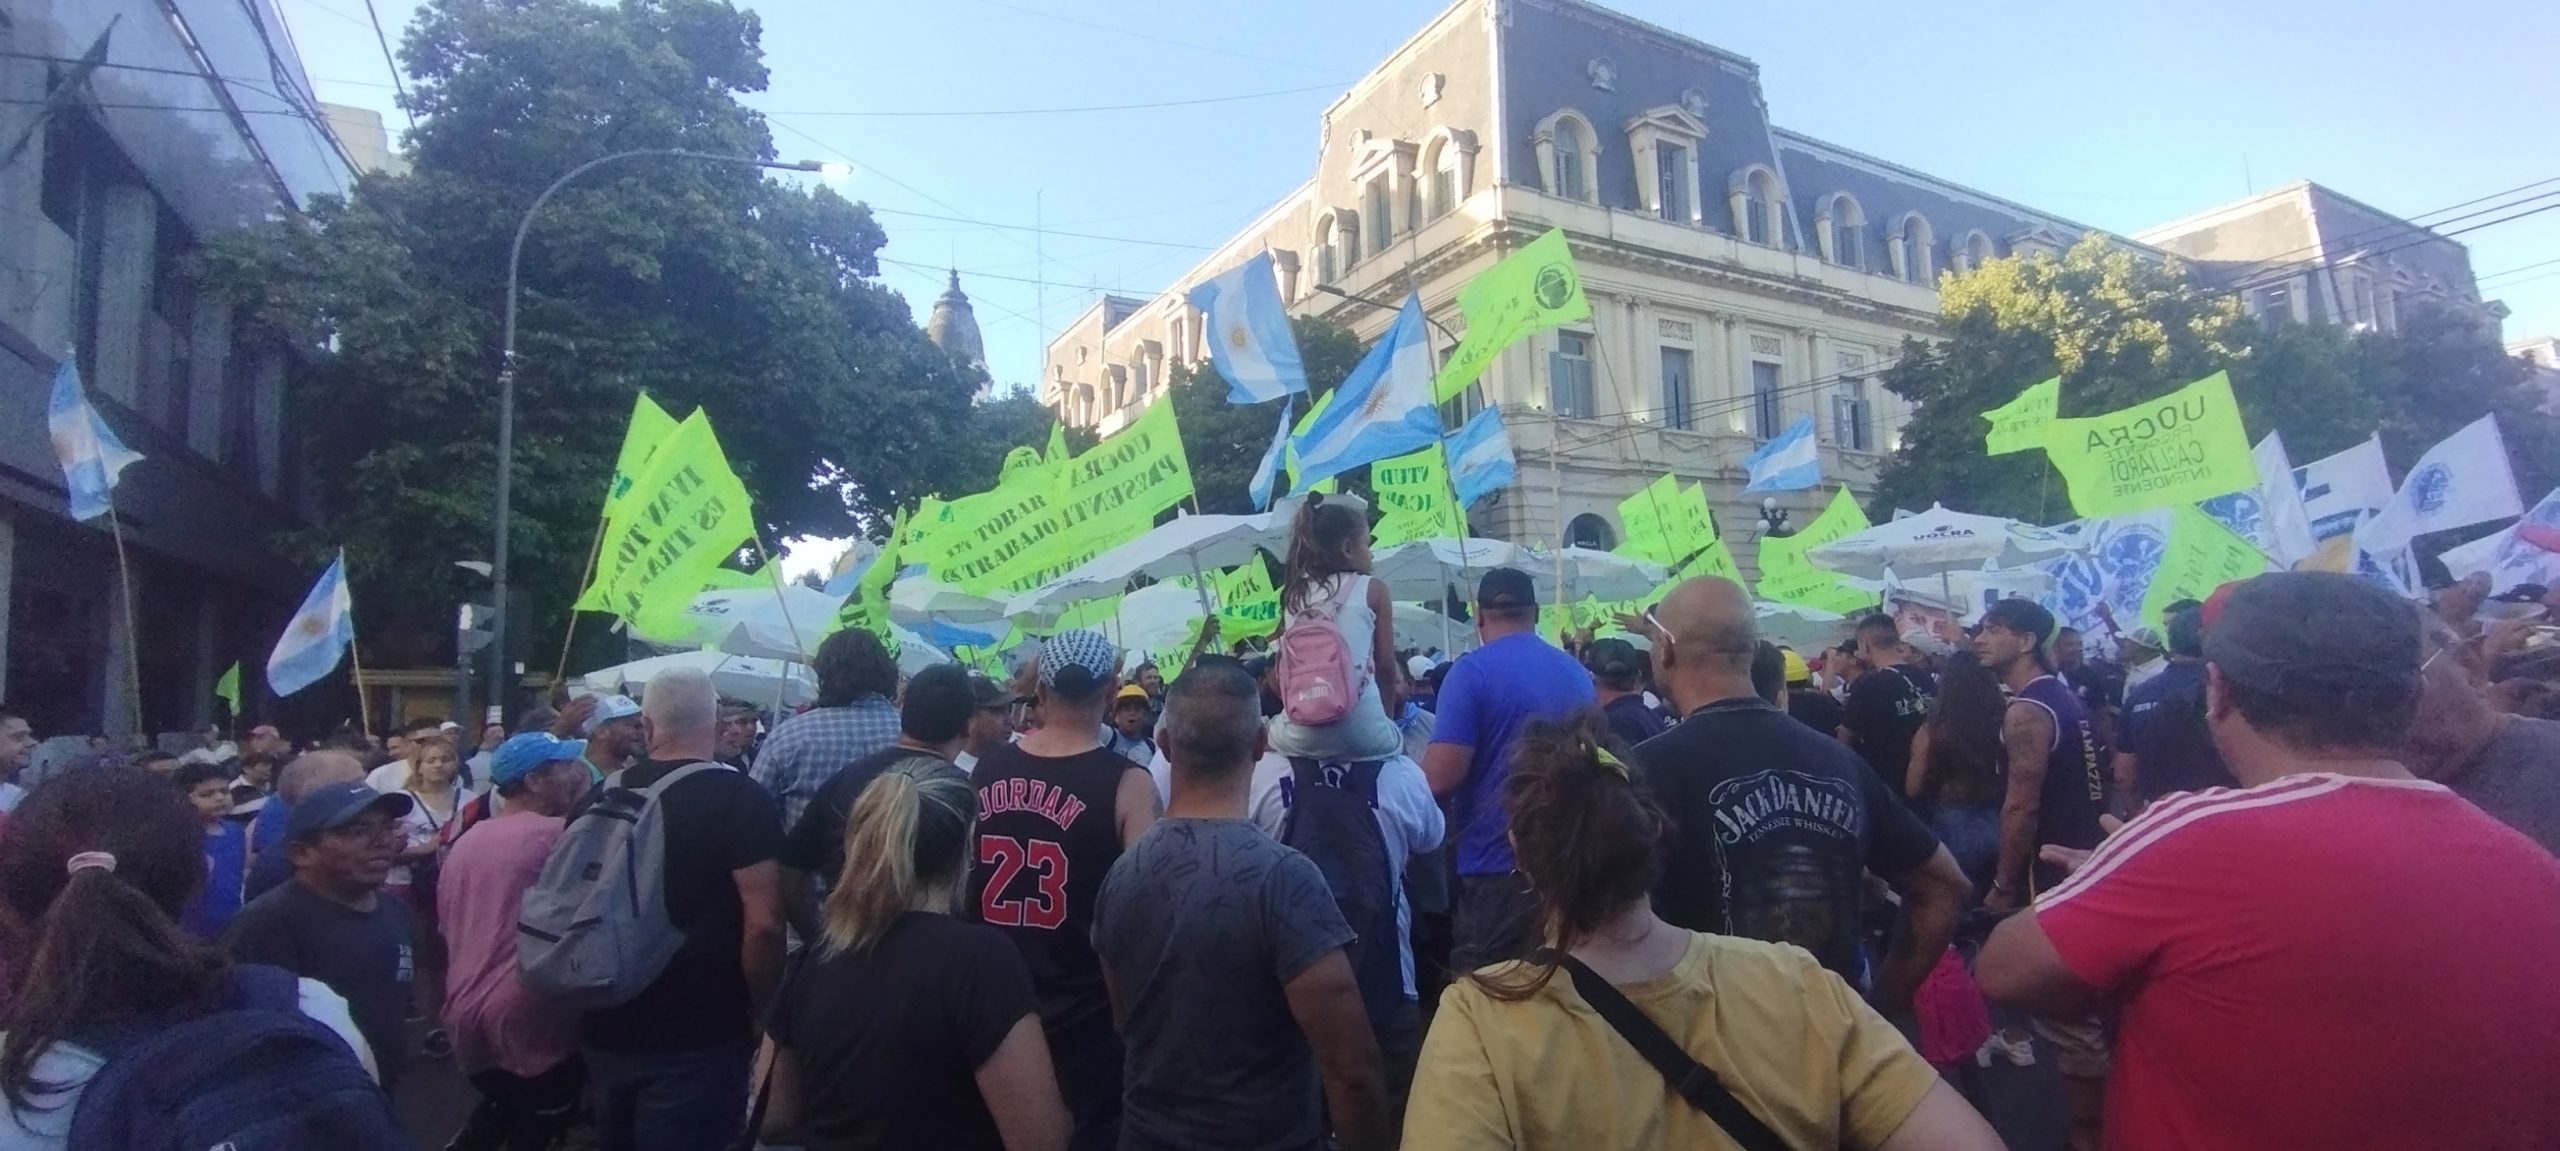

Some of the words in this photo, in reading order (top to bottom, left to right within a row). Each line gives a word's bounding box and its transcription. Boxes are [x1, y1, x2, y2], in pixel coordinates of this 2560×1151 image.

[974, 494, 1048, 543] TOBAR
[1913, 528, 1976, 542] UOCRA
[962, 517, 1060, 580] TRABAJO
[979, 777, 1087, 831] JORDAN
[1713, 786, 1773, 844] JACK
[1793, 817, 1846, 840] WHISKEY
[980, 834, 1069, 930] 23
